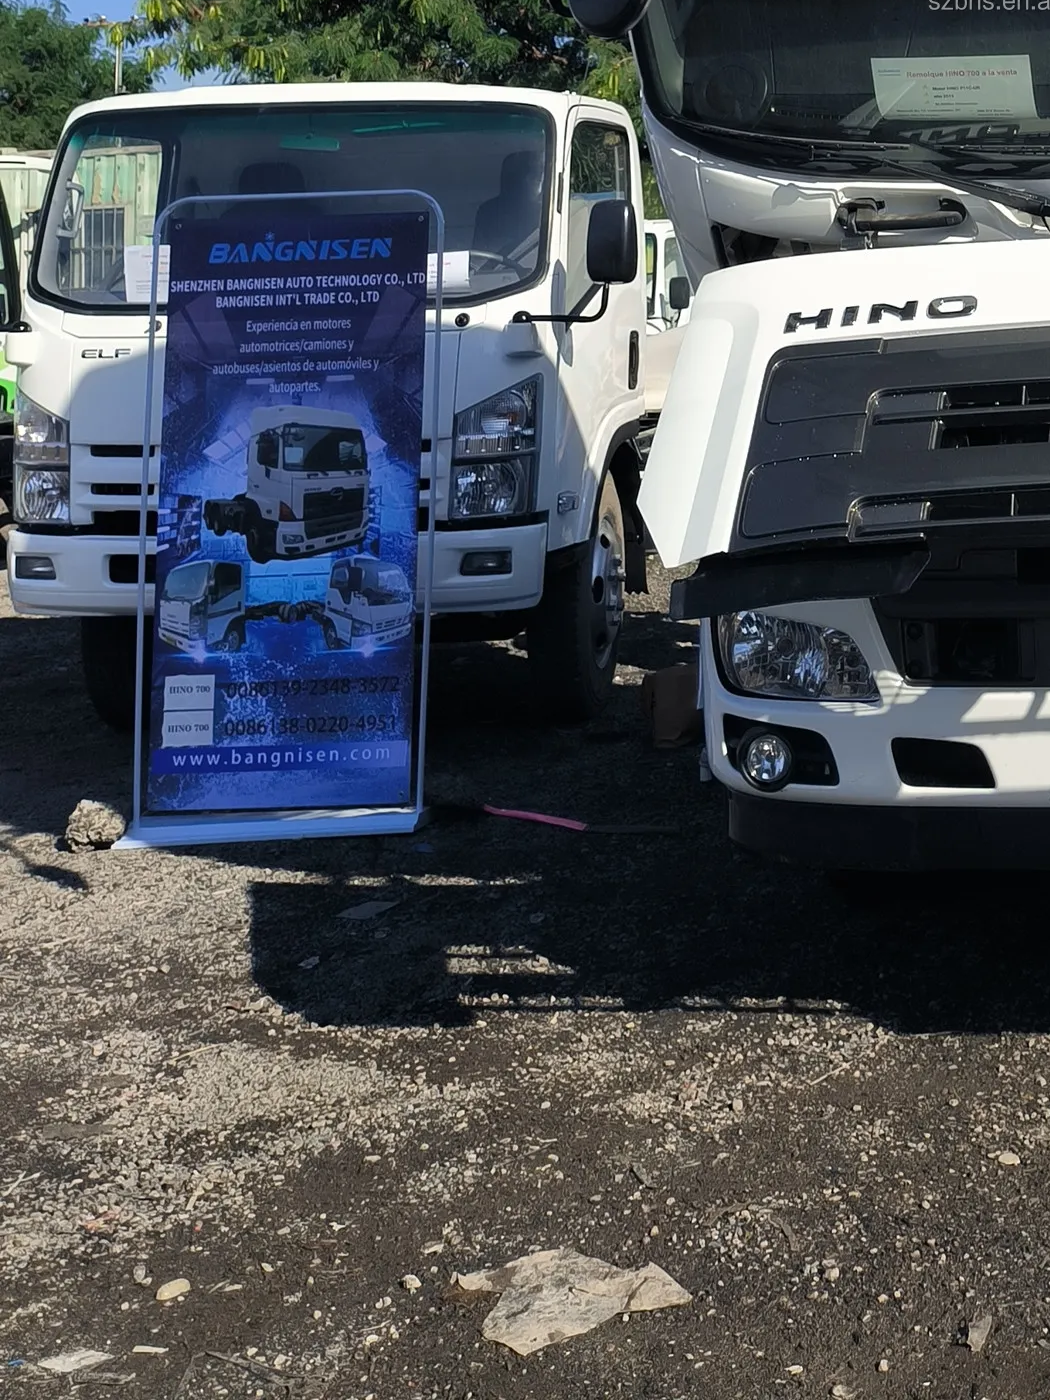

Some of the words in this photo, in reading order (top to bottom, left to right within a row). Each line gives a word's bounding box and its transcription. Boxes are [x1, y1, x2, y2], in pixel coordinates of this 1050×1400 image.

[906, 71, 943, 79] Remolque
[208, 237, 393, 264] BANGNISEN
[170, 280, 224, 293] SHENZHEN
[226, 278, 284, 291] BANGNISEN
[285, 276, 314, 289] AUTO
[316, 274, 382, 287] TECHNOLOGY
[384, 273, 405, 287] CO.,
[407, 272, 426, 284] LTD
[215, 295, 273, 308] BANGNISEN
[275, 293, 302, 306] INT'L
[304, 292, 336, 305] TRADE
[338, 292, 359, 305] CO.,
[360, 291, 380, 303] LTD
[783, 295, 978, 334] HINO
[246, 318, 299, 335] Experiencia
[300, 321, 312, 331] en
[313, 319, 352, 330] motores
[81, 348, 131, 359] ELF
[239, 337, 347, 354] automotrices/camiones
[347, 339, 354, 351] y
[212, 360, 301, 376] autobuses/asientos
[302, 359, 315, 372] de
[315, 356, 372, 371] automóviles
[373, 359, 380, 372] y
[269, 381, 321, 396] autopartes.
[169, 685, 193, 694] HINO
[195, 685, 211, 693] 700
[168, 724, 192, 733] HINO
[194, 724, 209, 732] 700
[172, 746, 391, 768] www.bangnisen.com
